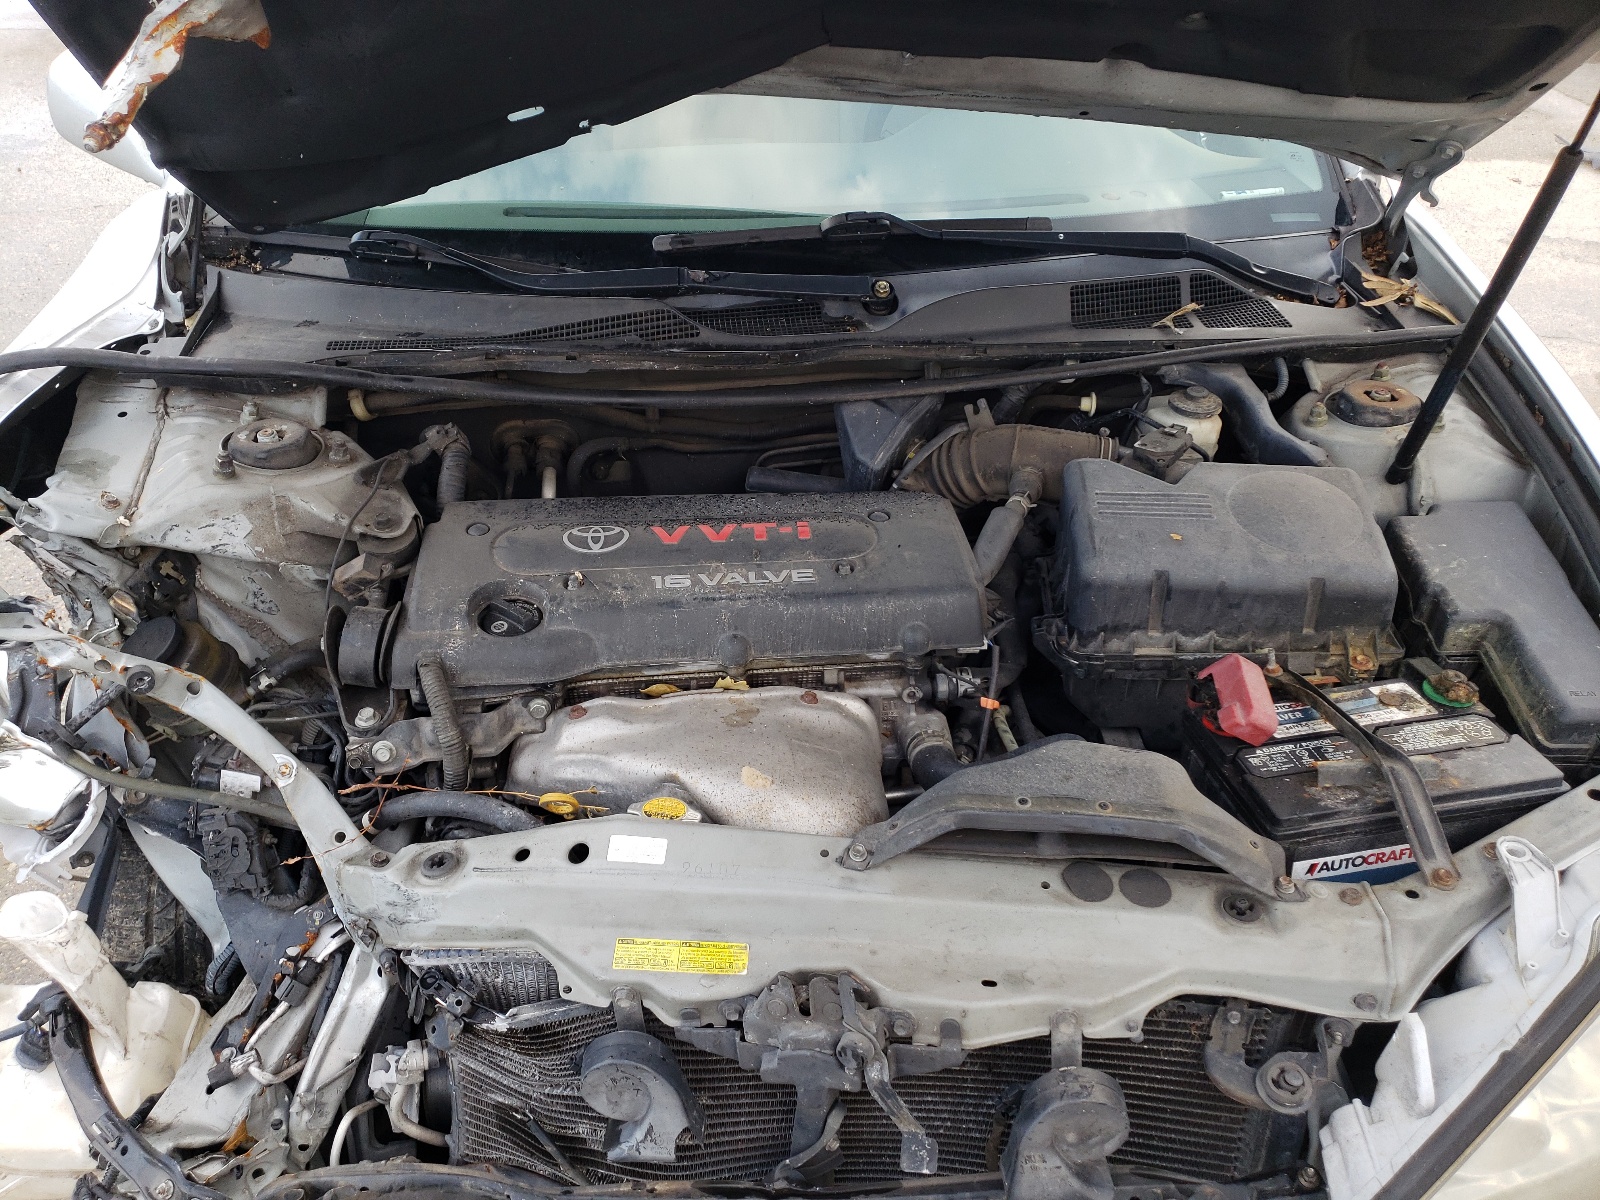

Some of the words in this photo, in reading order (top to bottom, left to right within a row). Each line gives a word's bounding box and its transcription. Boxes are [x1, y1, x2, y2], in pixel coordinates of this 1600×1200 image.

[651, 521, 811, 544] VVT-i
[651, 574, 691, 589] 16
[697, 568, 816, 587] VALVE
[1277, 711, 1305, 721] LVER
